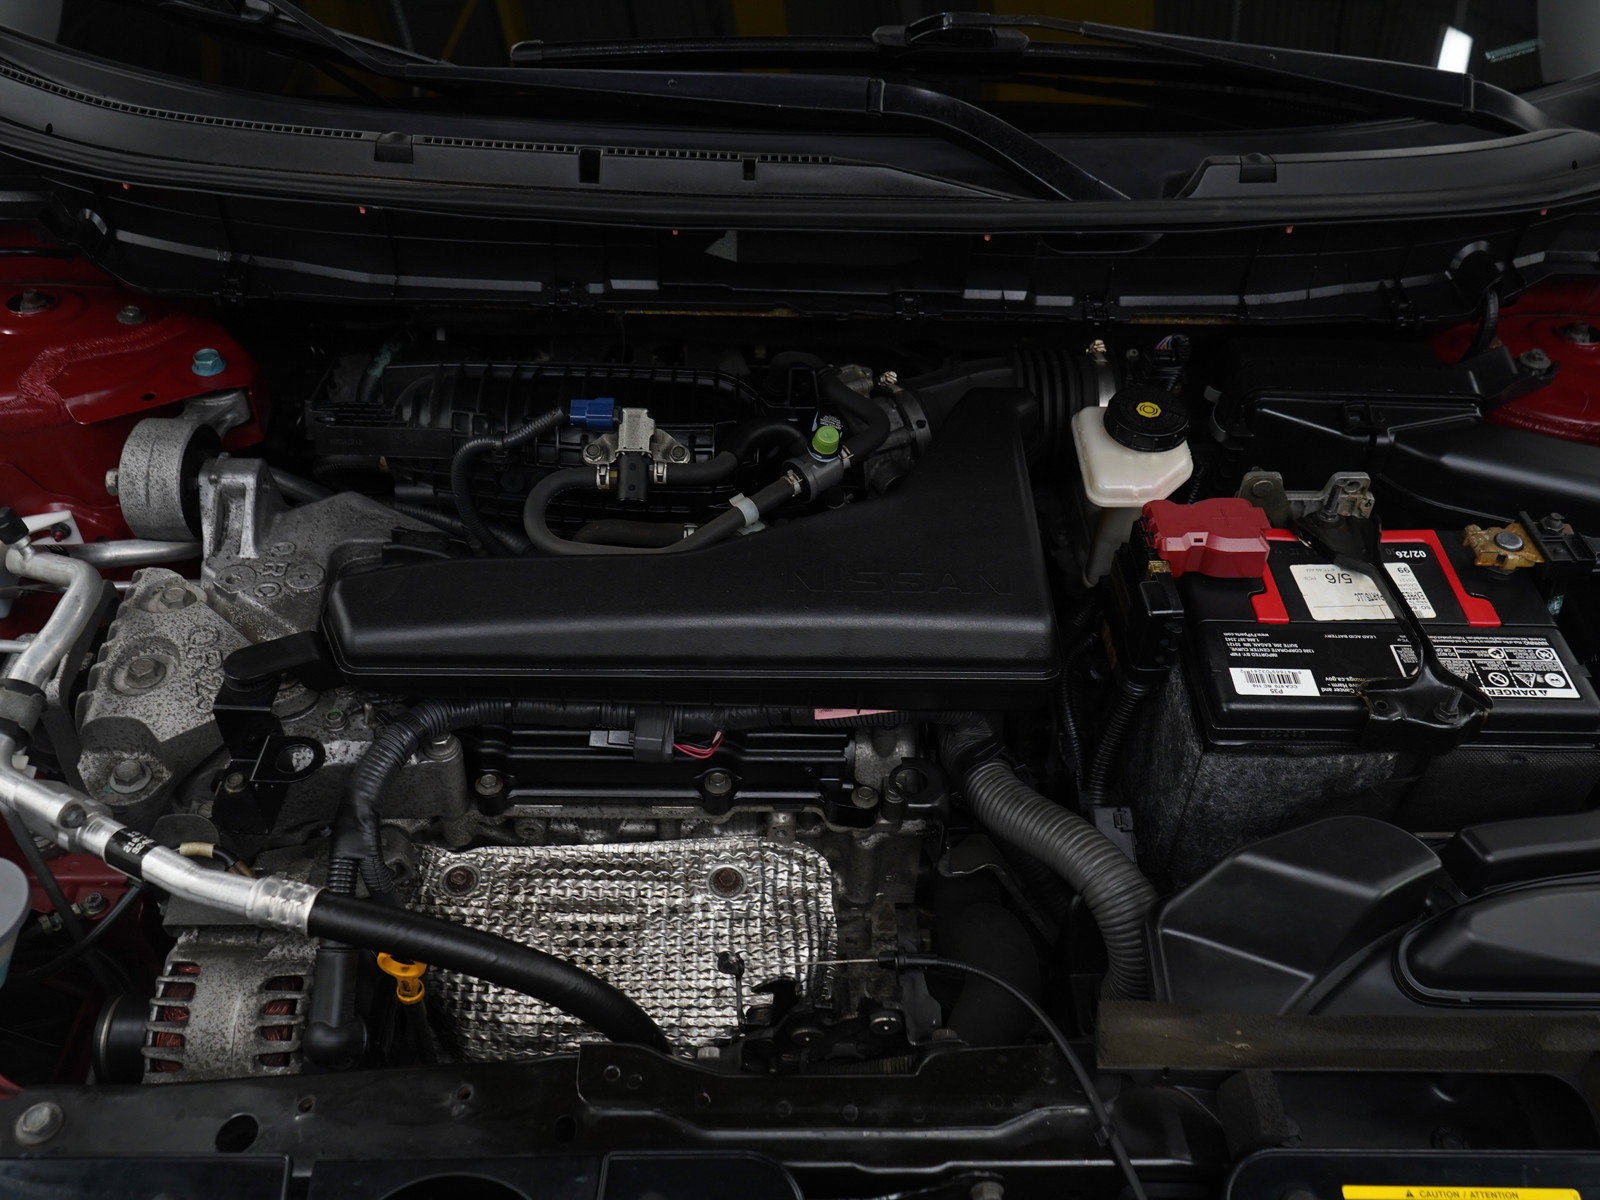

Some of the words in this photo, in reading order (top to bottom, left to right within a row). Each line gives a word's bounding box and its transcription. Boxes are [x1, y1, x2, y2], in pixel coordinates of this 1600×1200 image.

[1395, 550, 1427, 559] 02/26
[1324, 573, 1353, 584] 5/6
[786, 570, 1017, 598] NISSAN
[1419, 1190, 1460, 1199] CAUTION
[1469, 1191, 1520, 1200] ATTENTION
